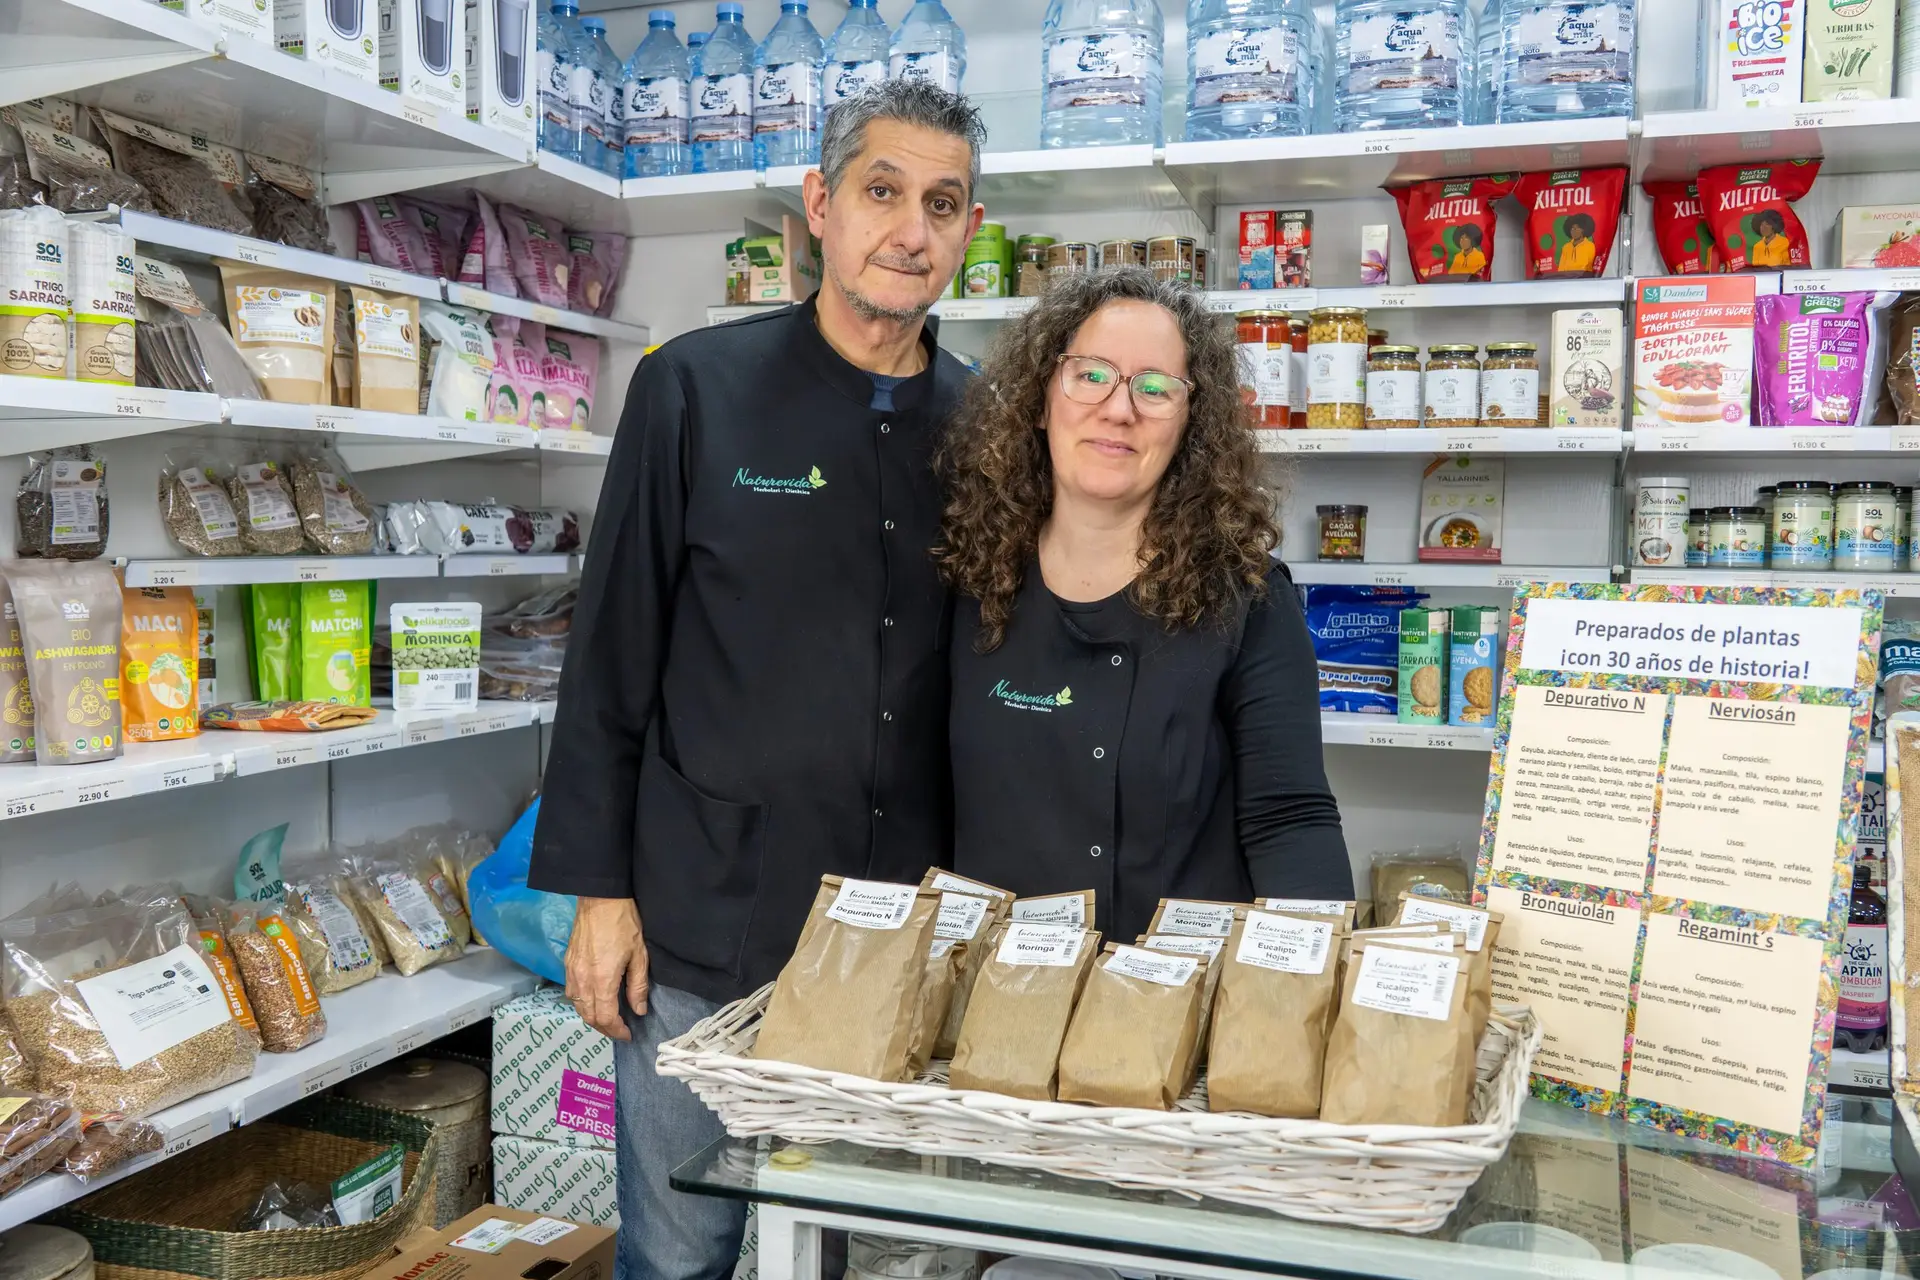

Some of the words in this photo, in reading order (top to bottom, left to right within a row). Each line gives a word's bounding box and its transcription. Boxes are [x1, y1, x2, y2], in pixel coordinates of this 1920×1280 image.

[1738, 0, 1783, 28] Bio
[1568, 20, 1594, 31] aqua
[1825, 23, 1874, 34] VERDURAS
[1397, 29, 1423, 41] aqua
[1237, 43, 1261, 56] aqua
[1760, 69, 1784, 77] CEREZA
[53, 133, 75, 147] SOL
[1534, 187, 1594, 210] XILITOL
[1719, 186, 1780, 212] XILITOL
[1424, 199, 1481, 221] XILITOL
[36, 243, 61, 257] SOL
[35, 280, 63, 293] TRIGO
[1663, 288, 1704, 298] Dambert
[1641, 313, 1668, 323] ZONDER
[1643, 321, 1696, 336] TAGATESSE
[1642, 344, 1732, 363] EDULCORANT
[1788, 318, 1810, 394] ERITRITOL
[1840, 356, 1858, 367] KETO
[117, 405, 134, 413] 2.95
[316, 421, 330, 429] 3.05
[732, 467, 810, 488] Naturevida
[1865, 508, 1882, 516] SOL
[63, 602, 90, 614] SOL
[311, 618, 363, 633] MATCHA
[1331, 613, 1390, 627] galletas
[72, 630, 91, 641] BIO
[405, 632, 472, 646] MORINGA
[1318, 628, 1344, 639] con
[1574, 619, 1685, 642] Preparados
[1690, 623, 1716, 643] de
[1721, 625, 1800, 648] plantas
[1452, 656, 1479, 665] AVENA
[1560, 648, 1601, 667] ¡con
[1606, 650, 1631, 668] 30
[1635, 652, 1683, 672] años
[1687, 654, 1714, 674] de
[1719, 655, 1810, 680] historia!
[426, 673, 439, 681] 240
[1327, 672, 1349, 684] para
[1352, 672, 1393, 687] Veganos
[988, 679, 1057, 706] Naturevida
[1543, 689, 1628, 709] Depurativo
[1632, 696, 1646, 711] N
[1709, 701, 1796, 722] Nerviosán
[1566, 735, 1610, 745] Composición:
[277, 757, 291, 765] 8.95
[1721, 753, 1770, 764] Composición:
[1669, 763, 1693, 773] Malva,
[1699, 767, 1739, 778] manzanilla,
[1745, 771, 1759, 780] tila,
[1764, 774, 1790, 782] espino
[1795, 775, 1824, 786] blanco,
[164, 777, 180, 787] 7.95
[1668, 776, 1702, 786] valeriana,
[1703, 780, 1737, 790] pasiflora,
[1738, 783, 1780, 795] malvavisco,
[1781, 788, 1809, 797] azahar,
[79, 791, 102, 803] 22.90
[1666, 787, 1685, 797] luisa,
[1691, 790, 1706, 798] cola
[1712, 792, 1722, 800] de
[1727, 795, 1756, 804] caballo,
[1762, 799, 1789, 808] melisa,
[7, 804, 28, 816] 9.25
[1665, 800, 1696, 809] amapola
[1566, 835, 1585, 843] Usos:
[1726, 838, 1745, 847] Usos:
[836, 905, 883, 919] Depurativo
[1520, 893, 1615, 921] Bronquiolán
[1175, 918, 1212, 928] Moringa
[1017, 943, 1055, 952] Moringa
[1257, 942, 1298, 955] Eucalipto
[1539, 938, 1584, 952] Composición:
[1266, 952, 1289, 962] Hojas
[278, 938, 313, 1001] sarraceno
[1841, 965, 1883, 978] APTAIN
[1376, 980, 1419, 994] Eucalipto
[1694, 973, 1743, 988] Composición:
[1840, 976, 1883, 986] OMBUCHA
[1385, 993, 1411, 1003] Hojas
[1842, 990, 1875, 998] RASPBERRY
[1701, 1036, 1721, 1047] Usos:
[530, 1029, 584, 1084] plameca
[1634, 1038, 1656, 1049] Malas
[1662, 1044, 1705, 1061] digestiones,
[1711, 1055, 1748, 1071] dispepsia,
[1755, 1066, 1788, 1079] gastritis,
[1631, 1063, 1654, 1074] acidez
[1654, 1068, 1684, 1082] gástrica,
[1633, 1051, 1655, 1063] gases,
[1656, 1057, 1692, 1070] espasmos
[1693, 1065, 1760, 1087] gastrointestinales,
[1762, 1079, 1786, 1092] fatiga,
[1854, 1075, 1874, 1084] 3.50
[577, 1078, 612, 1097] Ontime
[584, 1106, 600, 1118] XS
[165, 1141, 185, 1157] 14.60
